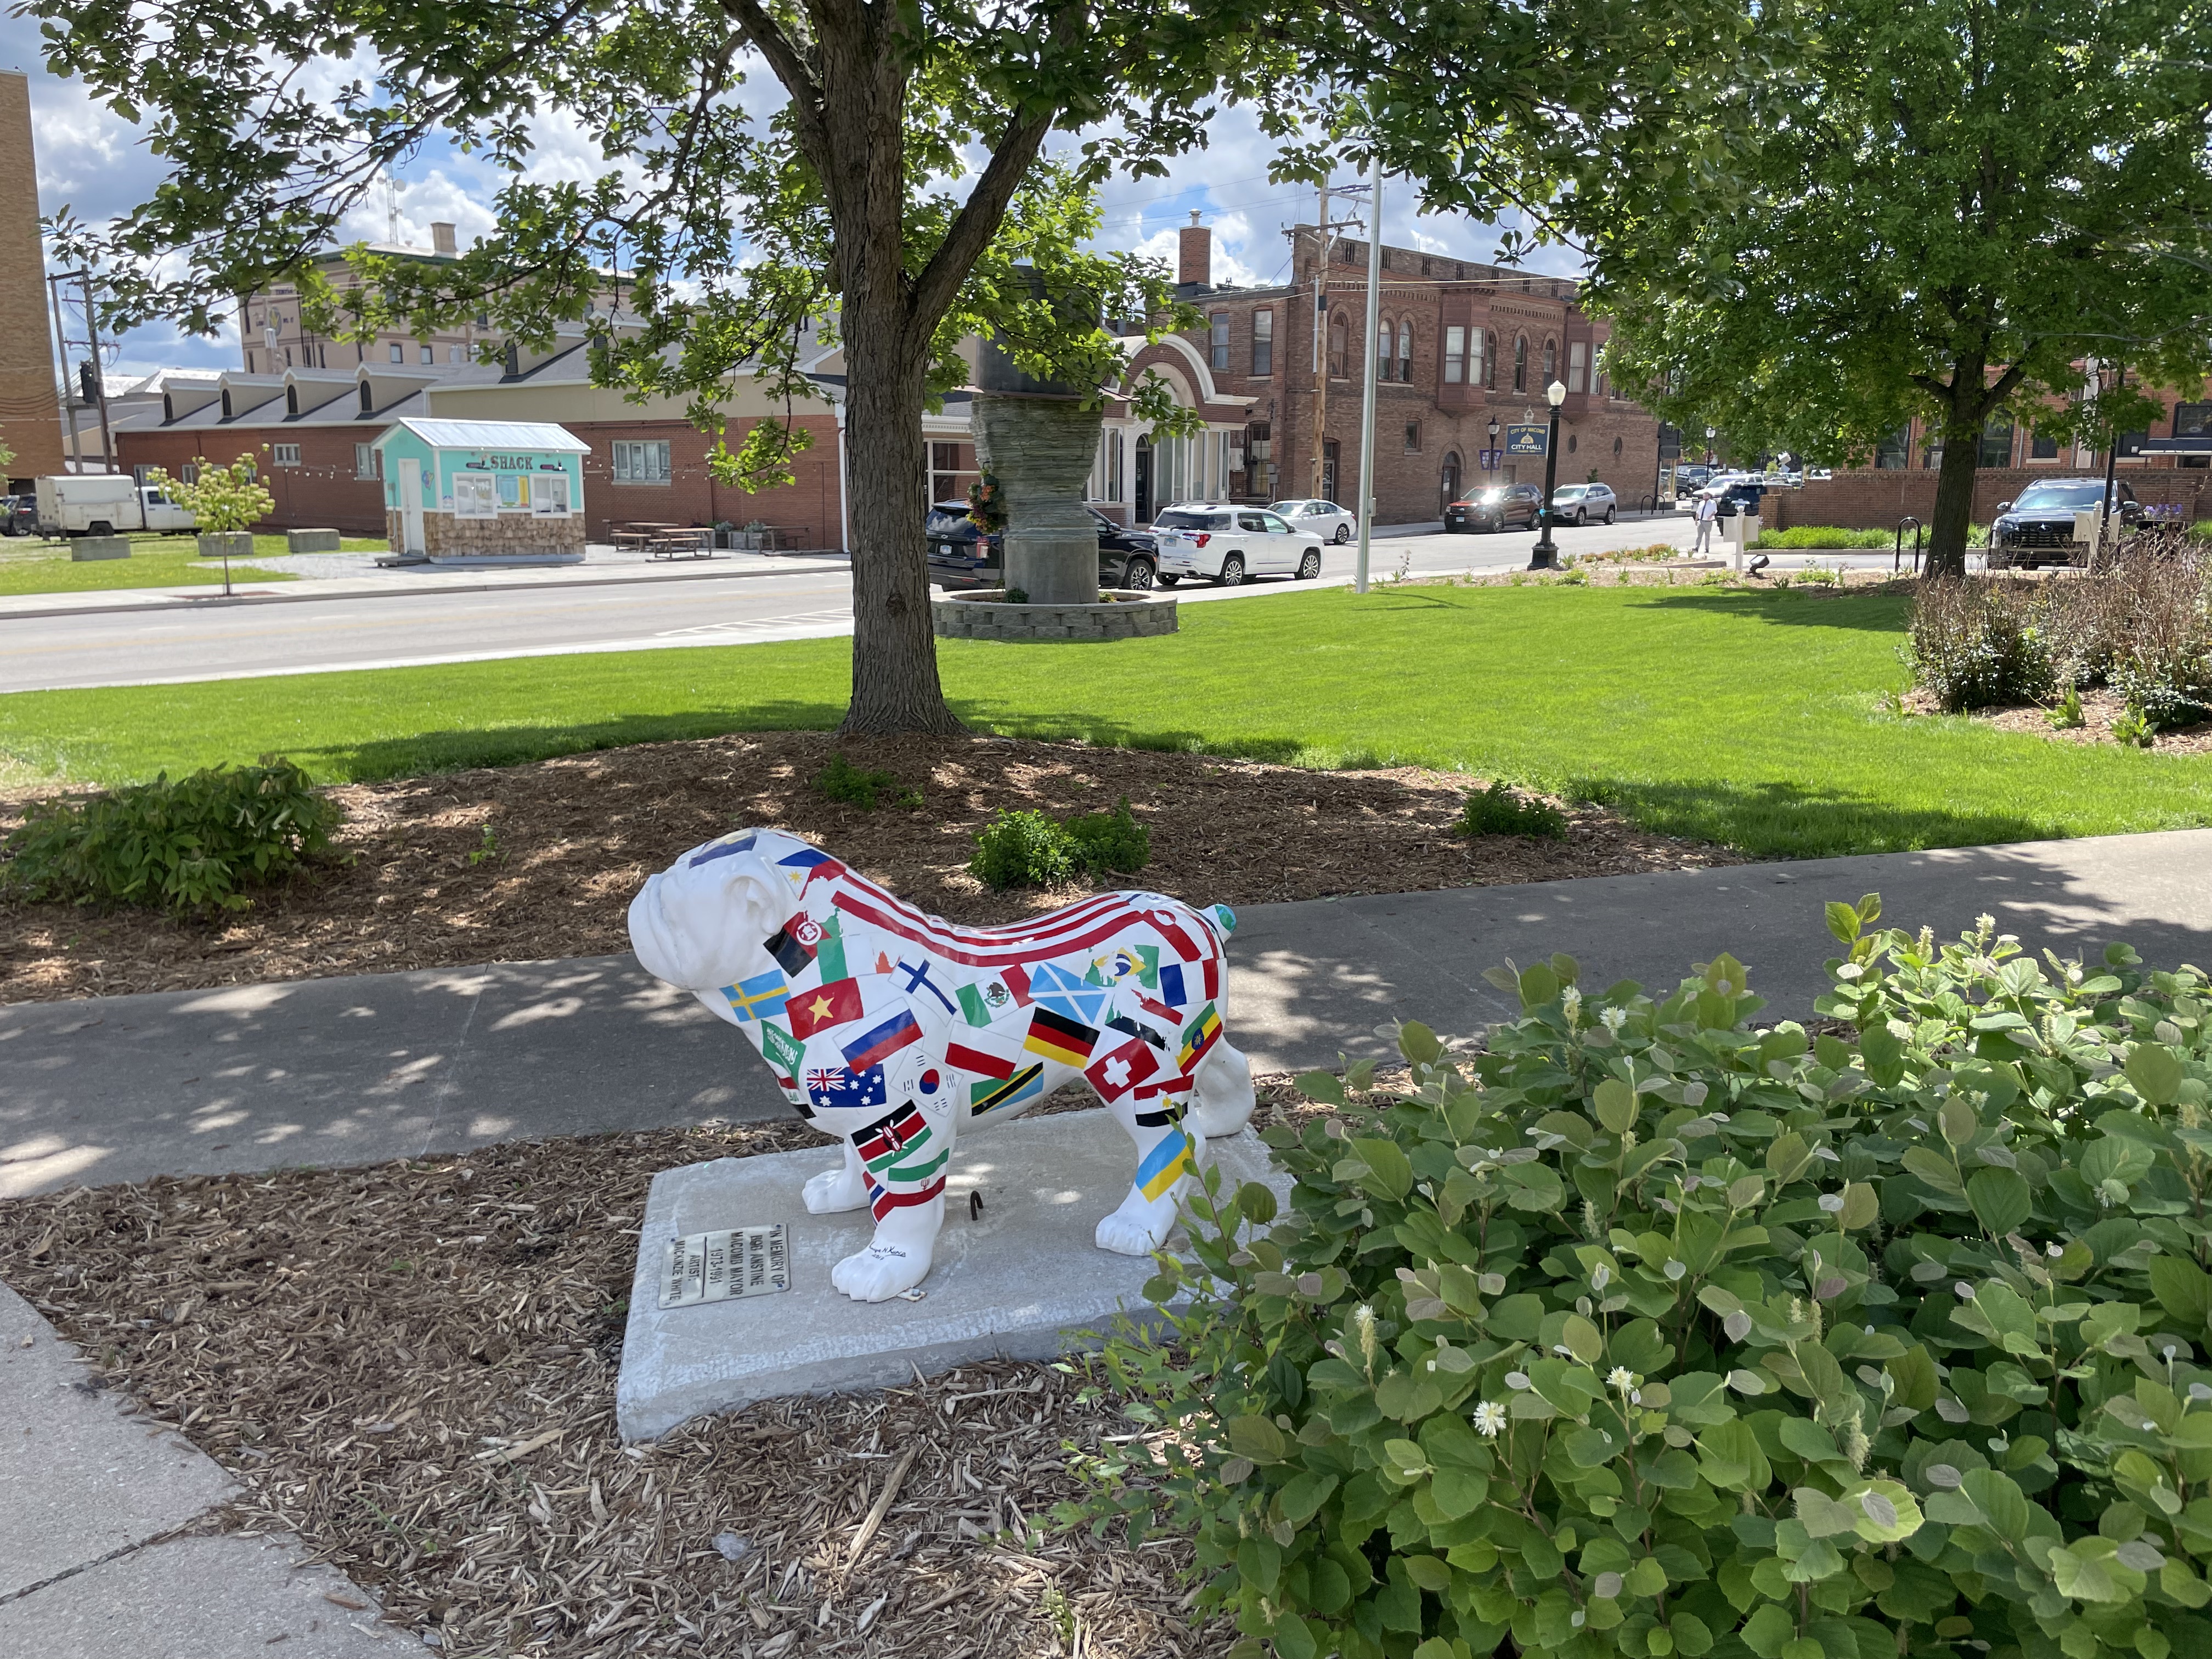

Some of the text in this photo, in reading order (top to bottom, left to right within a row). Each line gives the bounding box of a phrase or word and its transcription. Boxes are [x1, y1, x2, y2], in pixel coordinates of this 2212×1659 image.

[490, 456, 533, 470] SHACK
[669, 1240, 685, 1301] MACKINZIE WHITE
[688, 1255, 701, 1281] ARTIST:
[709, 1248, 724, 1284] 1973-1991
[730, 1232, 744, 1296] MACOMB MAYOR
[750, 1235, 764, 1286] BOB ANSTINE
[769, 1229, 785, 1285] IN MEMORY OF
